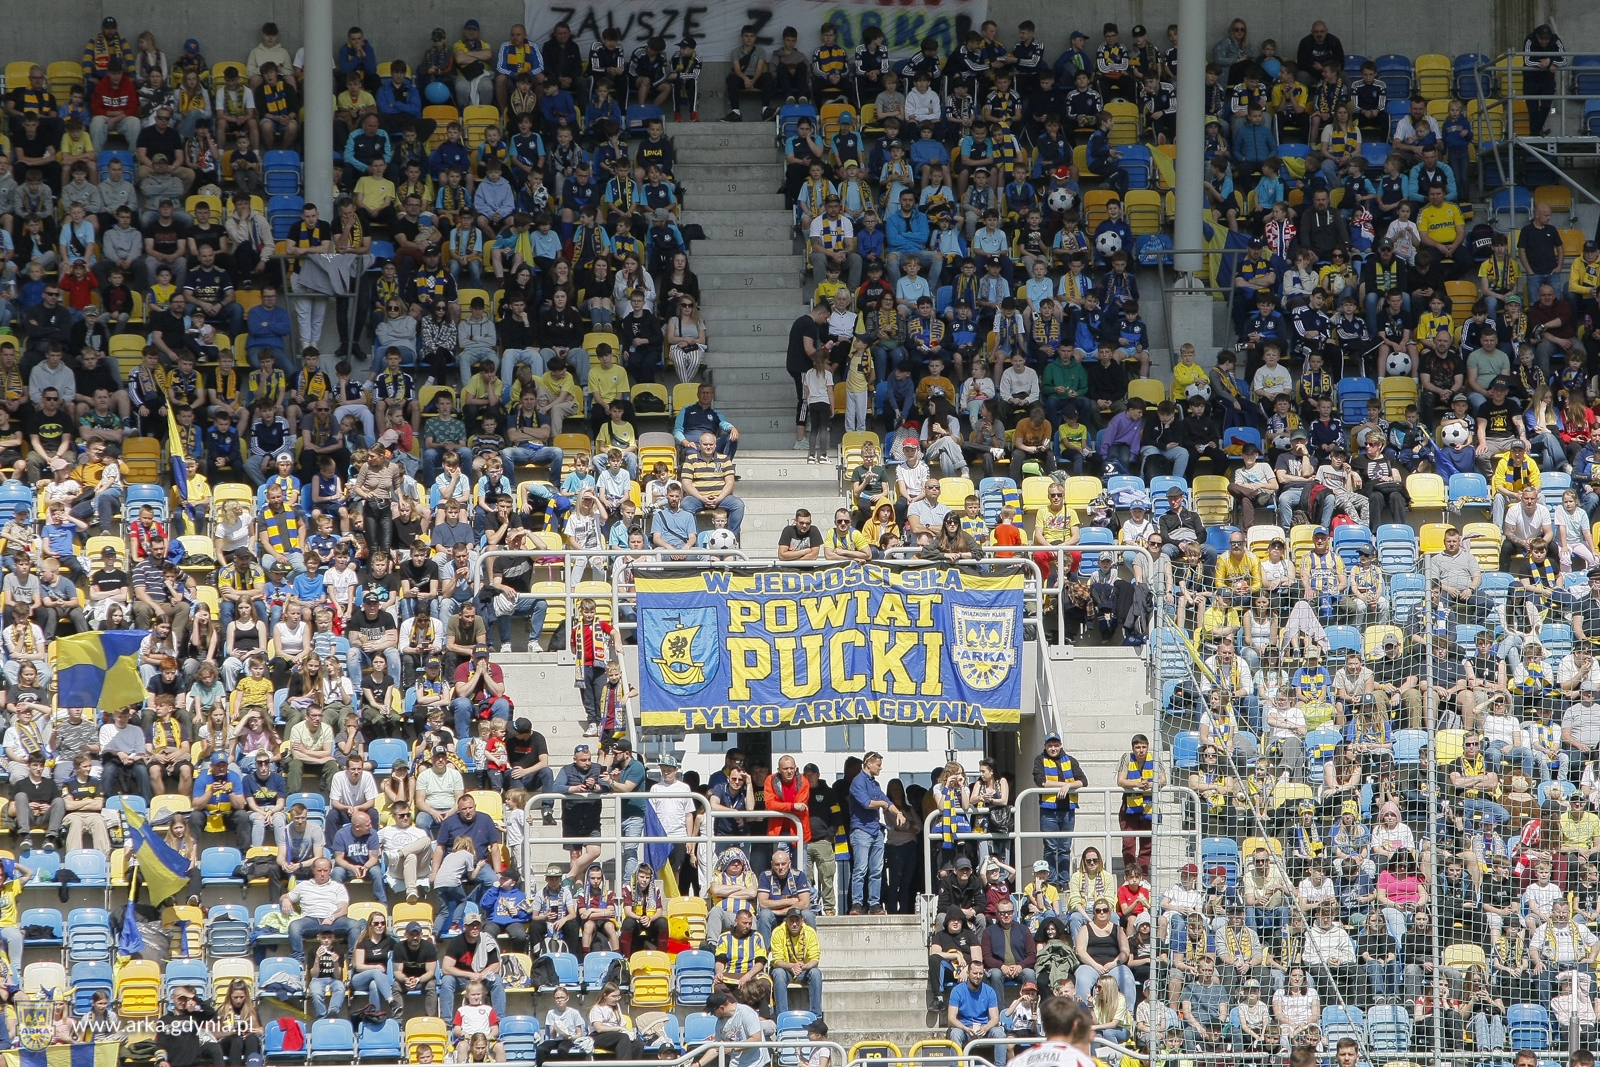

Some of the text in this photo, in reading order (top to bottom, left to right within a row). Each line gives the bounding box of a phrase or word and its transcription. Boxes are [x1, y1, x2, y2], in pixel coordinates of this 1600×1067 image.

[551, 7, 708, 42] ZAWSZE
[747, 8, 773, 45] Z
[719, 138, 729, 147] 20
[727, 184, 737, 192] 19
[734, 229, 744, 237] 18
[744, 277, 754, 286] 17
[752, 324, 762, 332] 16
[760, 372, 770, 381] 15
[769, 420, 779, 428] 14
[778, 468, 788, 477] 13
[702, 561, 964, 595] W JEDNOŚCI SIŁA
[12, 586, 32, 597] VANS
[726, 590, 943, 633] POWIAT
[960, 650, 1007, 662] ARKA
[726, 628, 944, 701] PUCKI
[1086, 666, 1092, 675] 9
[539, 671, 546, 680] 9
[678, 697, 987, 730] TYLKO ARKA GDYNIA
[1100, 720, 1106, 729] 8
[551, 725, 558, 734] 8
